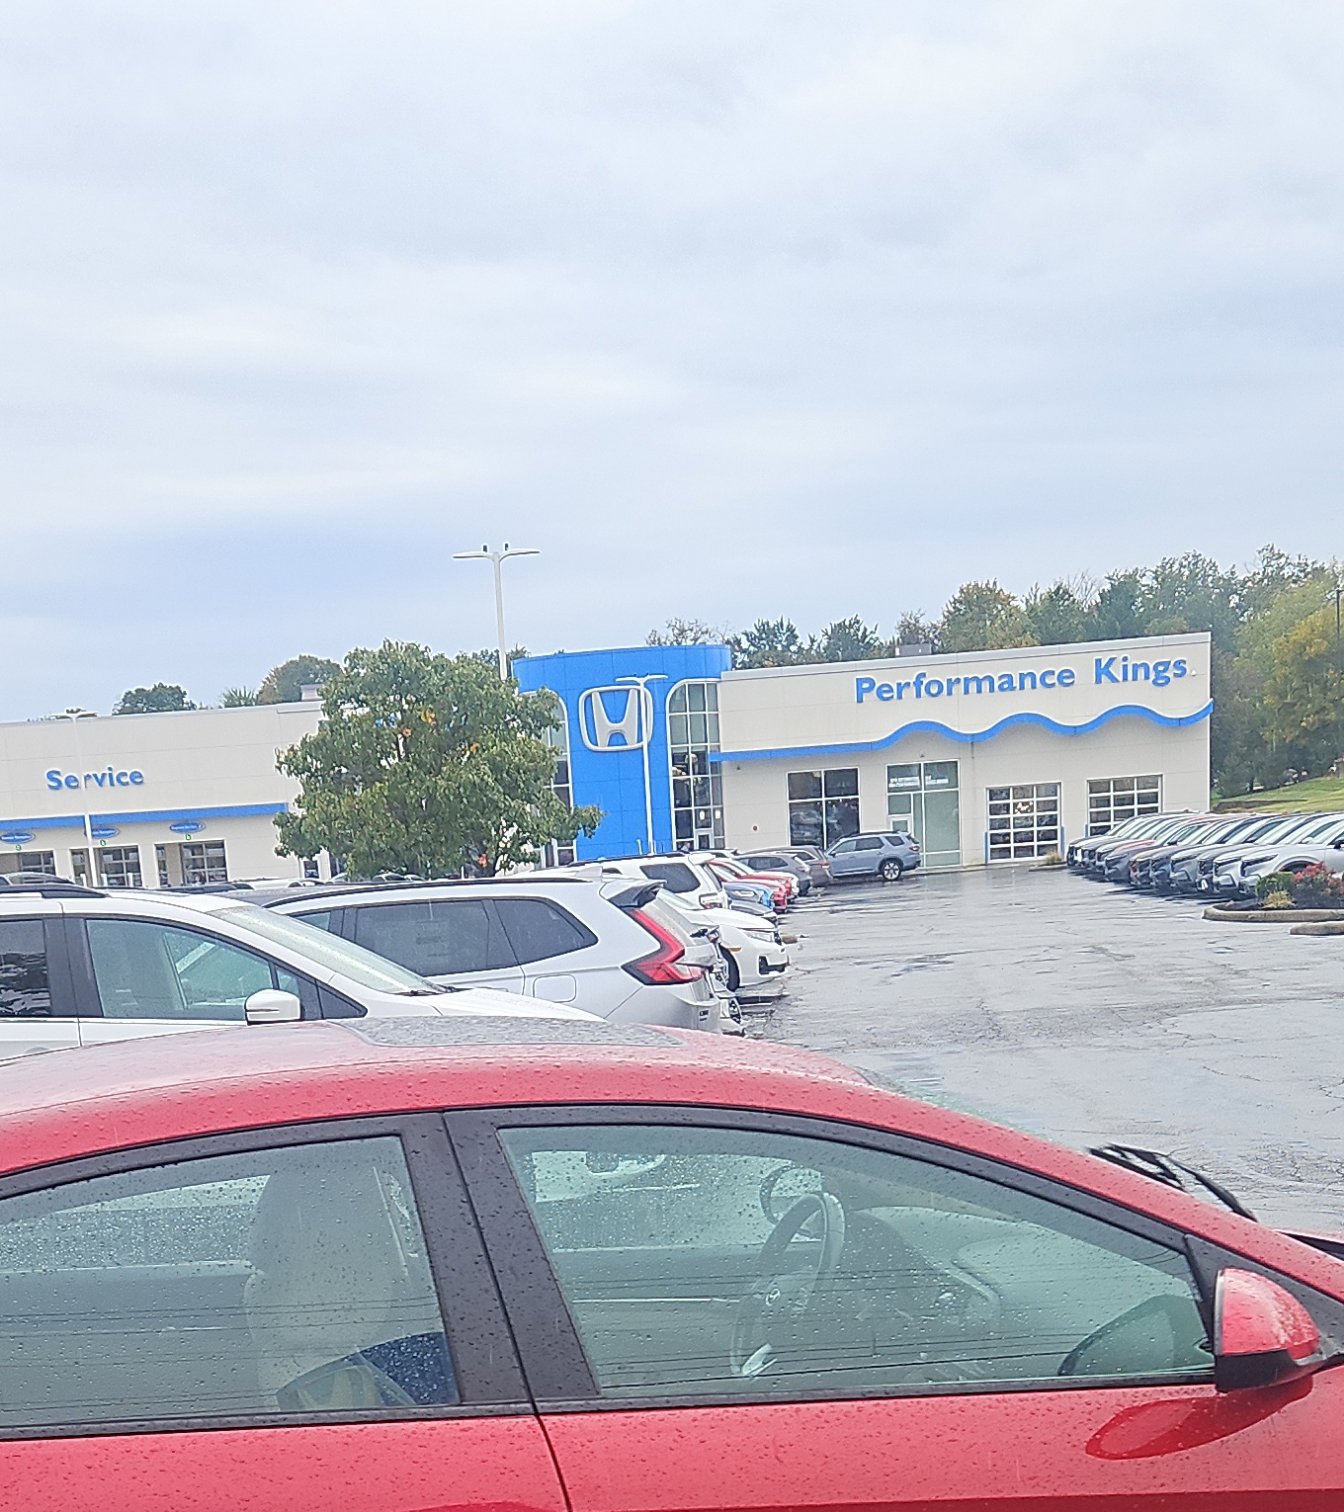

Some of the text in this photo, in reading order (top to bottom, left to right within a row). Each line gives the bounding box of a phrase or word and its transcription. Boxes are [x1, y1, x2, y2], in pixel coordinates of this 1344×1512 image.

[855, 656, 1188, 703] Performance Kings
[45, 765, 144, 791] Service
